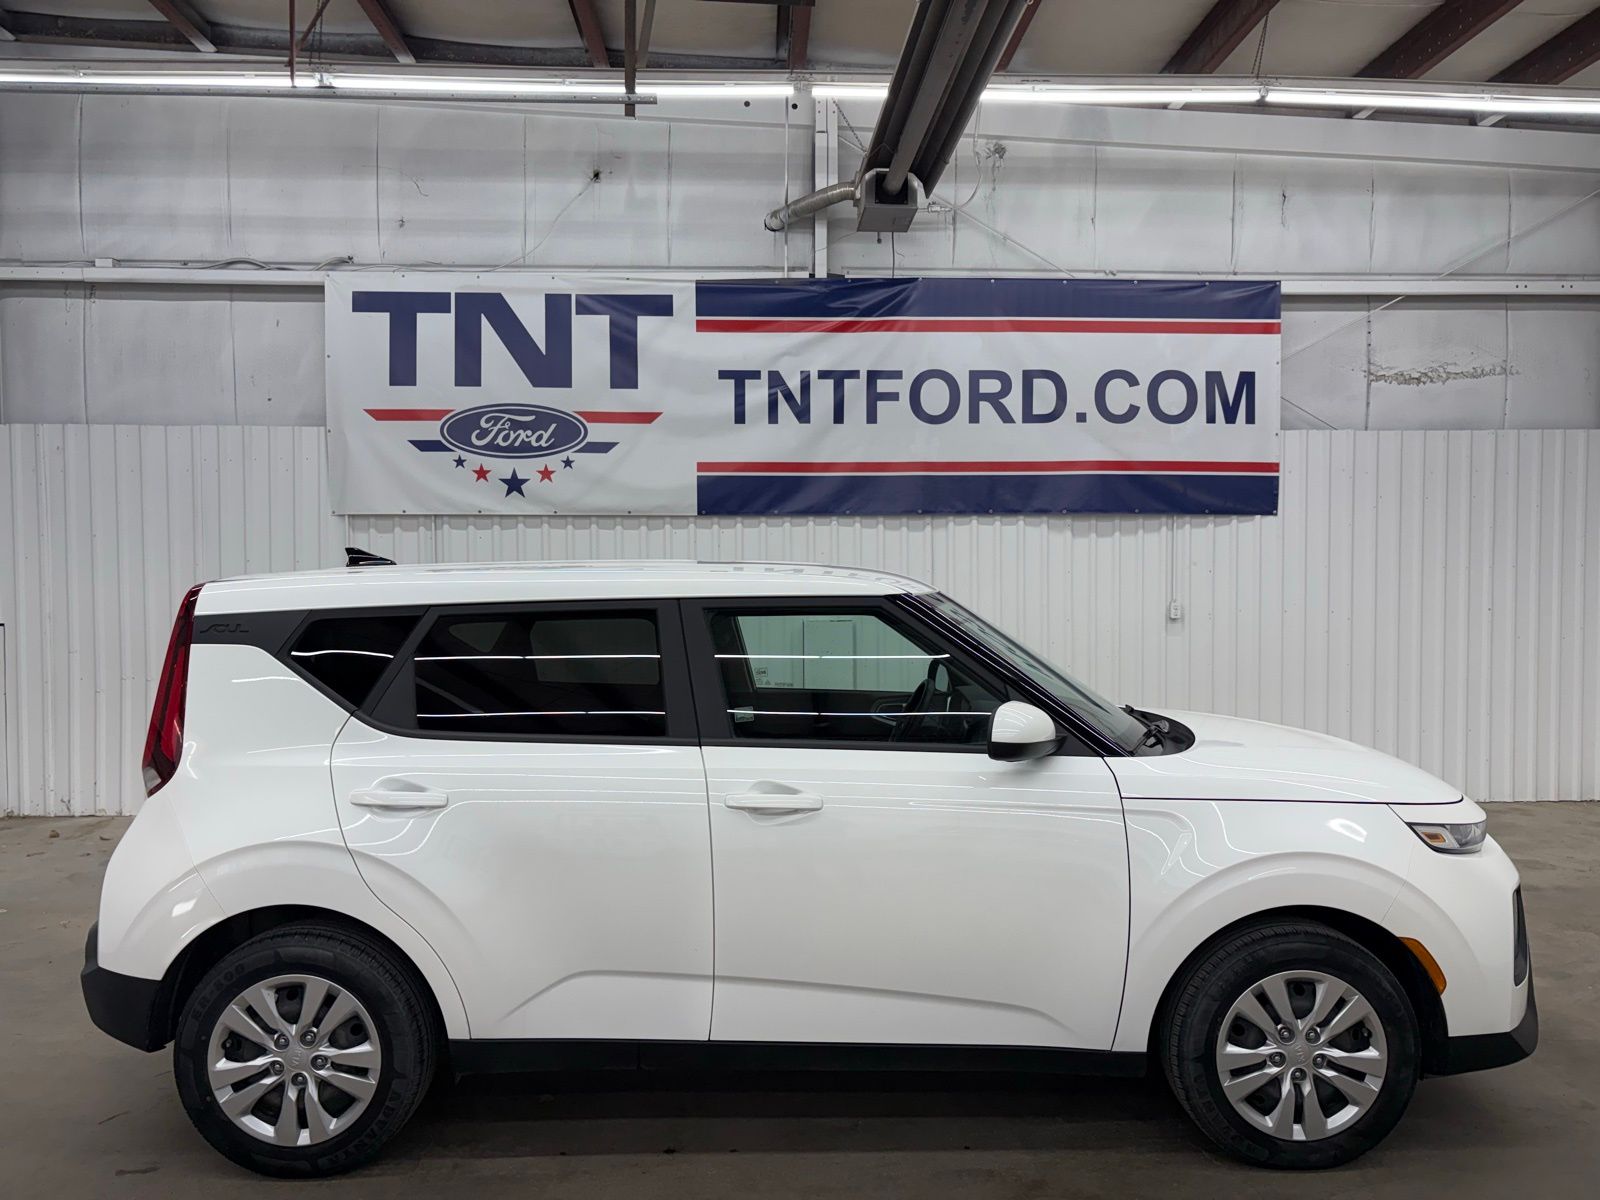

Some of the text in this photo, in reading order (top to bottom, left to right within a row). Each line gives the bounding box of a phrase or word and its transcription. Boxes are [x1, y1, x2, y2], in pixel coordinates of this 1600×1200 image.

[352, 291, 673, 389] TNT
[718, 369, 1255, 424] TNTFORD.COM
[471, 413, 557, 447] Ford
